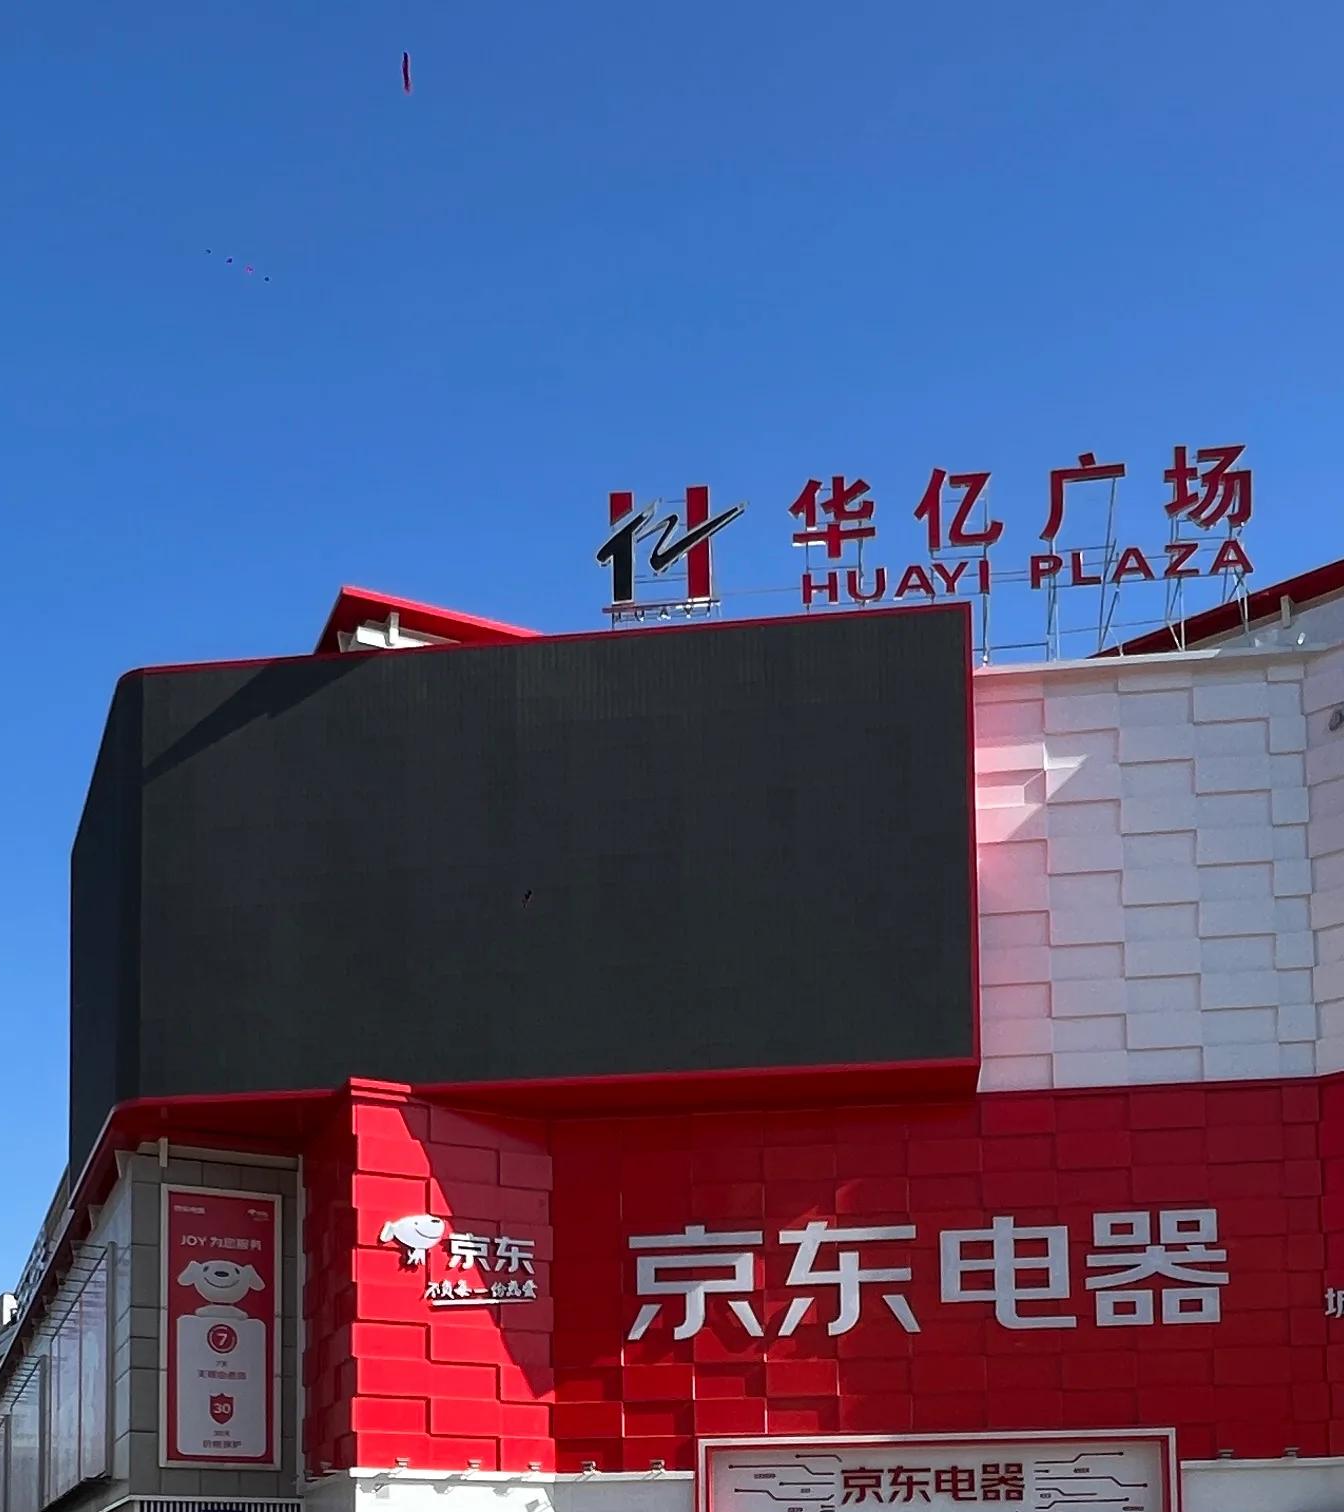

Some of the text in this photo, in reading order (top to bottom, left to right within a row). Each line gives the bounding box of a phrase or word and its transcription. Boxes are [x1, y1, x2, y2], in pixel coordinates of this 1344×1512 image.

[789, 445, 1253, 559] 华亿广场
[801, 539, 1254, 604] HUAYI PLAZA
[180, 1234, 207, 1247] JOY
[449, 1232, 535, 1275] 京东
[628, 1208, 1229, 1341] 京东电器
[217, 1333, 228, 1345] 7
[213, 1403, 231, 1414] 30
[841, 1463, 1025, 1505] 京东电器
